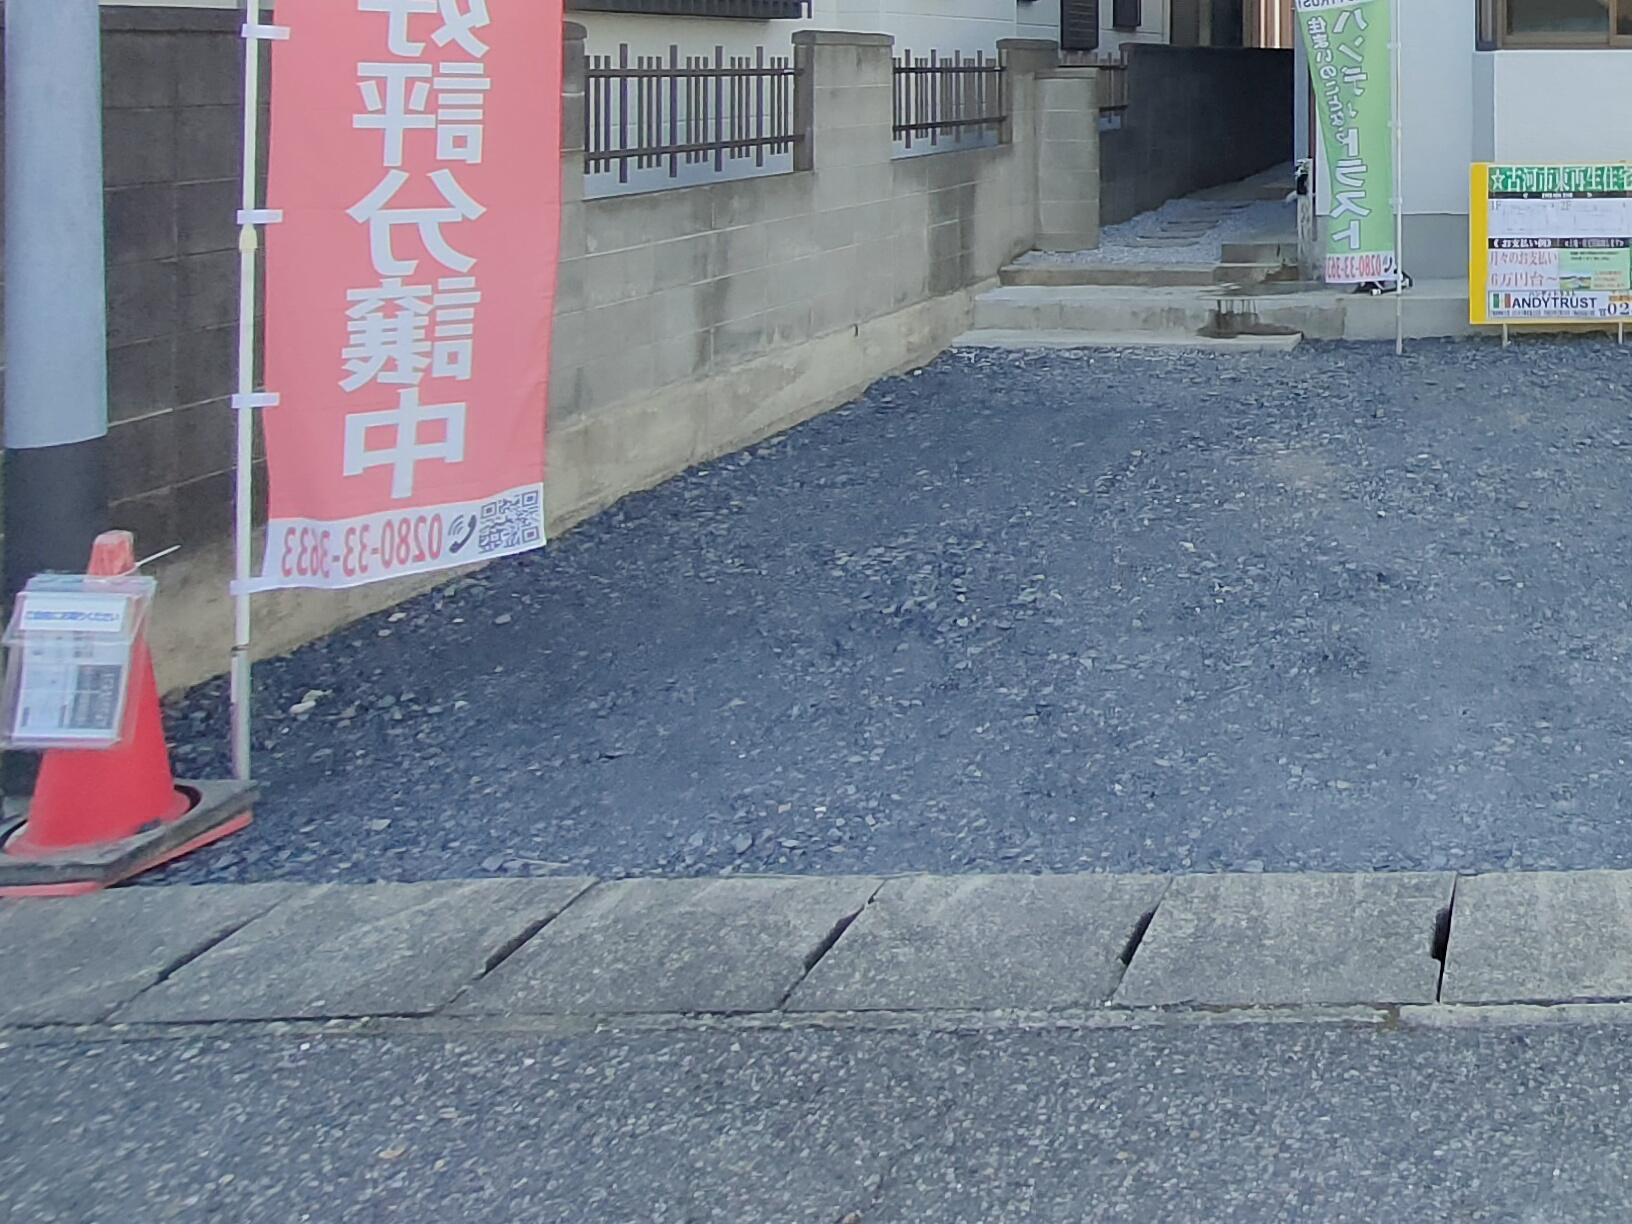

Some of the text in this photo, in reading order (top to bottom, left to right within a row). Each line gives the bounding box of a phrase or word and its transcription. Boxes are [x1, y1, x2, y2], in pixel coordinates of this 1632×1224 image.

[1490, 251, 1557, 266] 月々のお支払い
